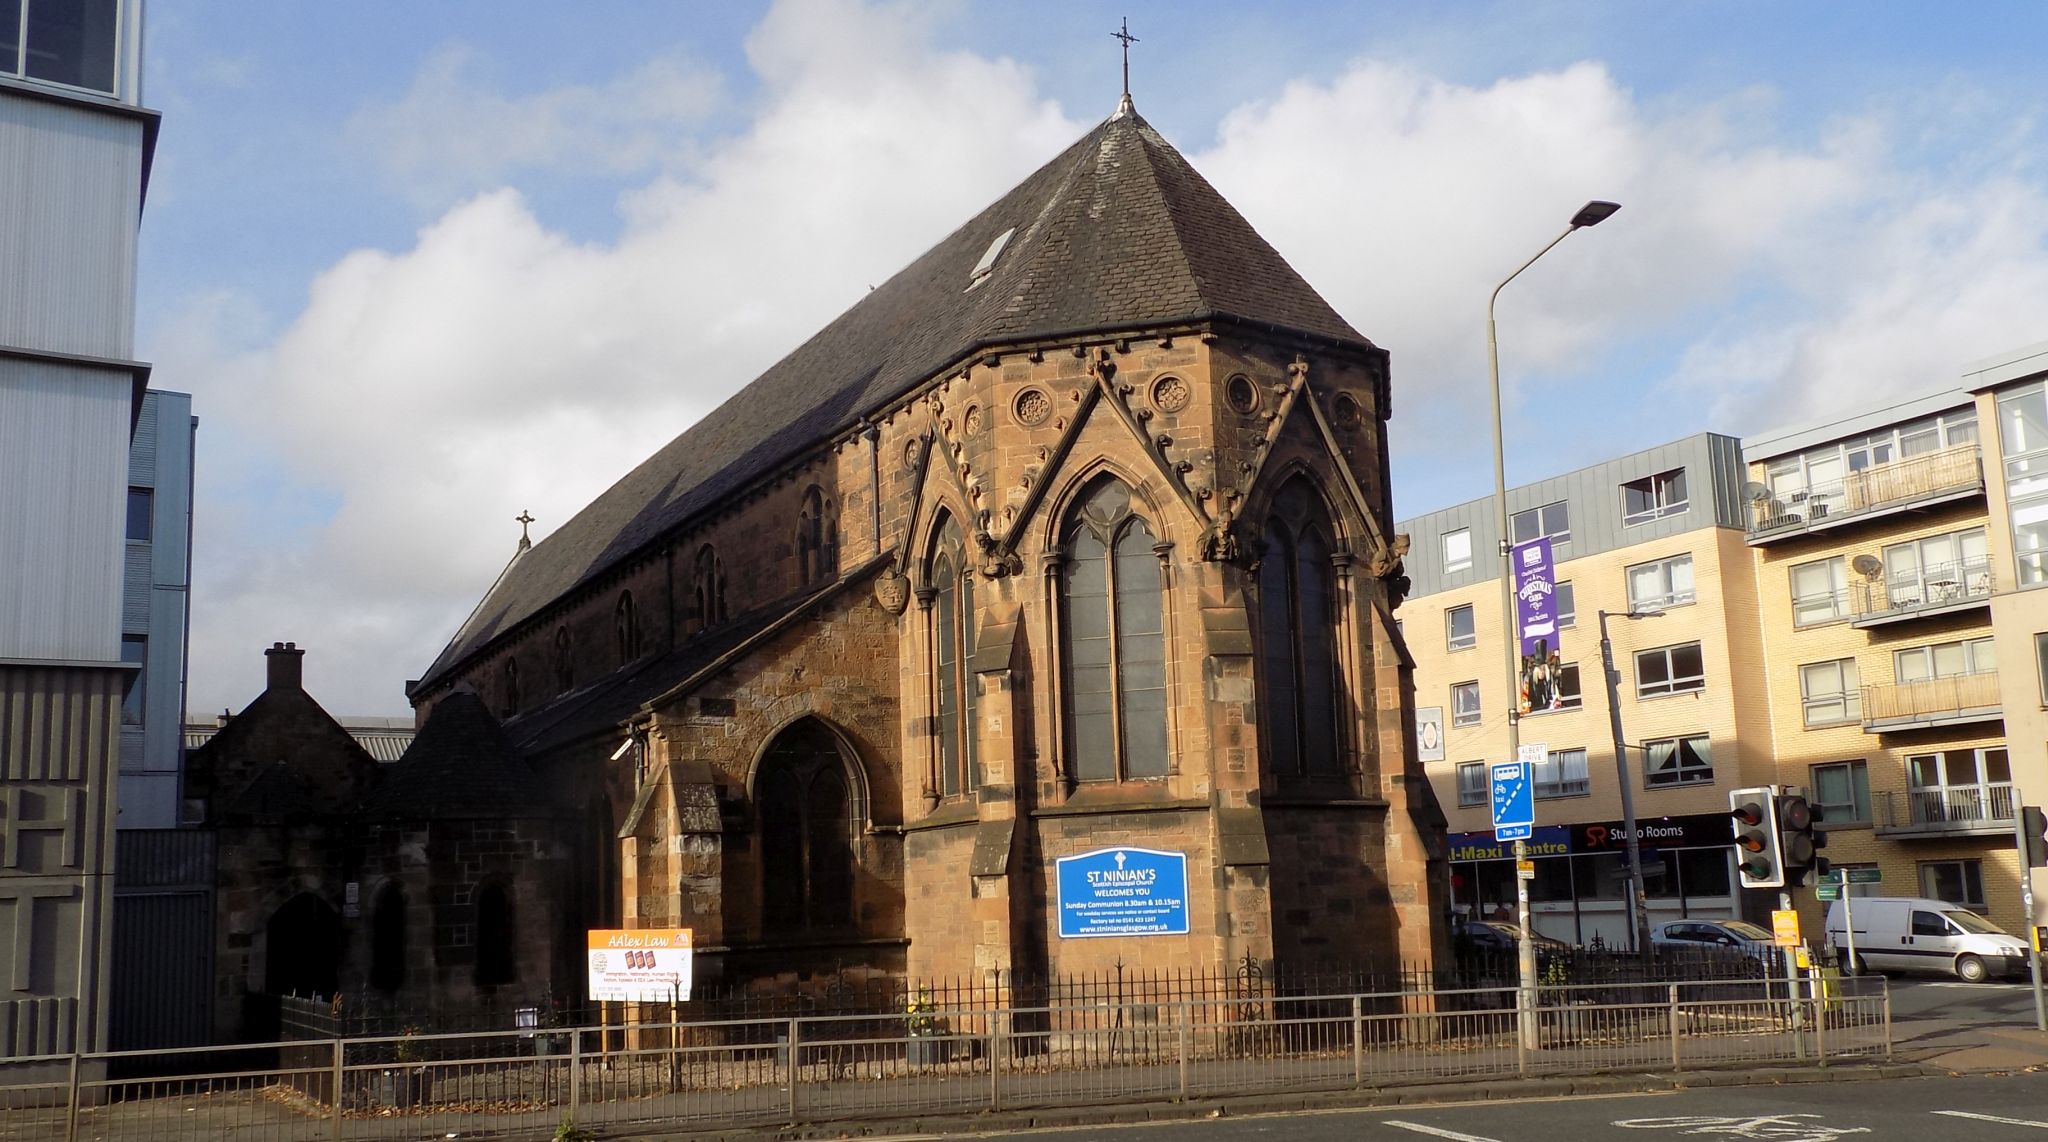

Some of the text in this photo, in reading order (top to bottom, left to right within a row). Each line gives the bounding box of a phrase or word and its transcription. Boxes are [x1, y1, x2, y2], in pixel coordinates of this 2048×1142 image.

[1610, 825, 1684, 840] Stuo Rooms
[1447, 844, 1503, 861] l-Maxi
[1087, 868, 1156, 883] ST NINIAN'S
[1094, 887, 1150, 897] WELCOMES YOU
[1065, 902, 1087, 910] Sunday
[1155, 898, 1181, 906] 10.15am
[608, 934, 668, 947] AAlex Law
